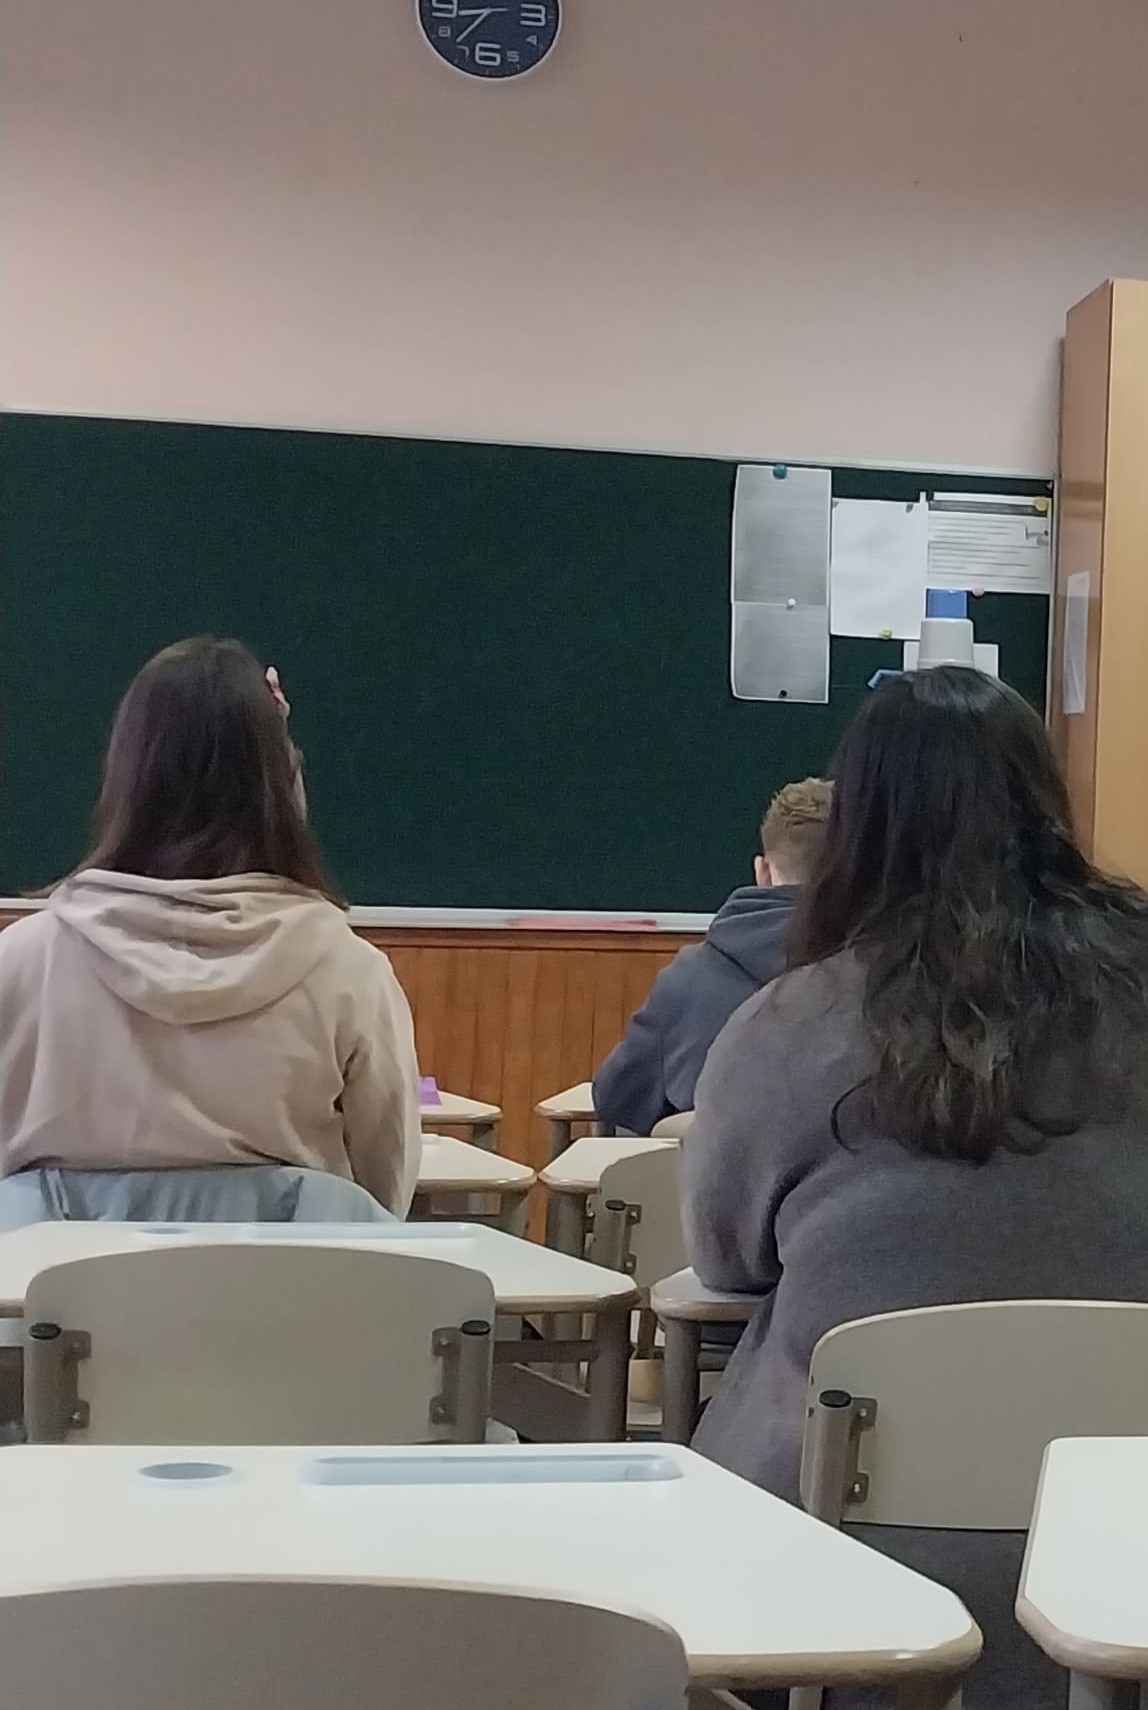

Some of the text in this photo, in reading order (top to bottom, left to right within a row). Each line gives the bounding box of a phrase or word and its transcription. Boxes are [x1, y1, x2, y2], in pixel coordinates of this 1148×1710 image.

[432, 0, 458, 18] 9
[520, 3, 546, 27] 3
[438, 26, 451, 38] 8
[456, 45, 470, 63] 7
[474, 42, 502, 67] 6
[506, 51, 521, 62] 5
